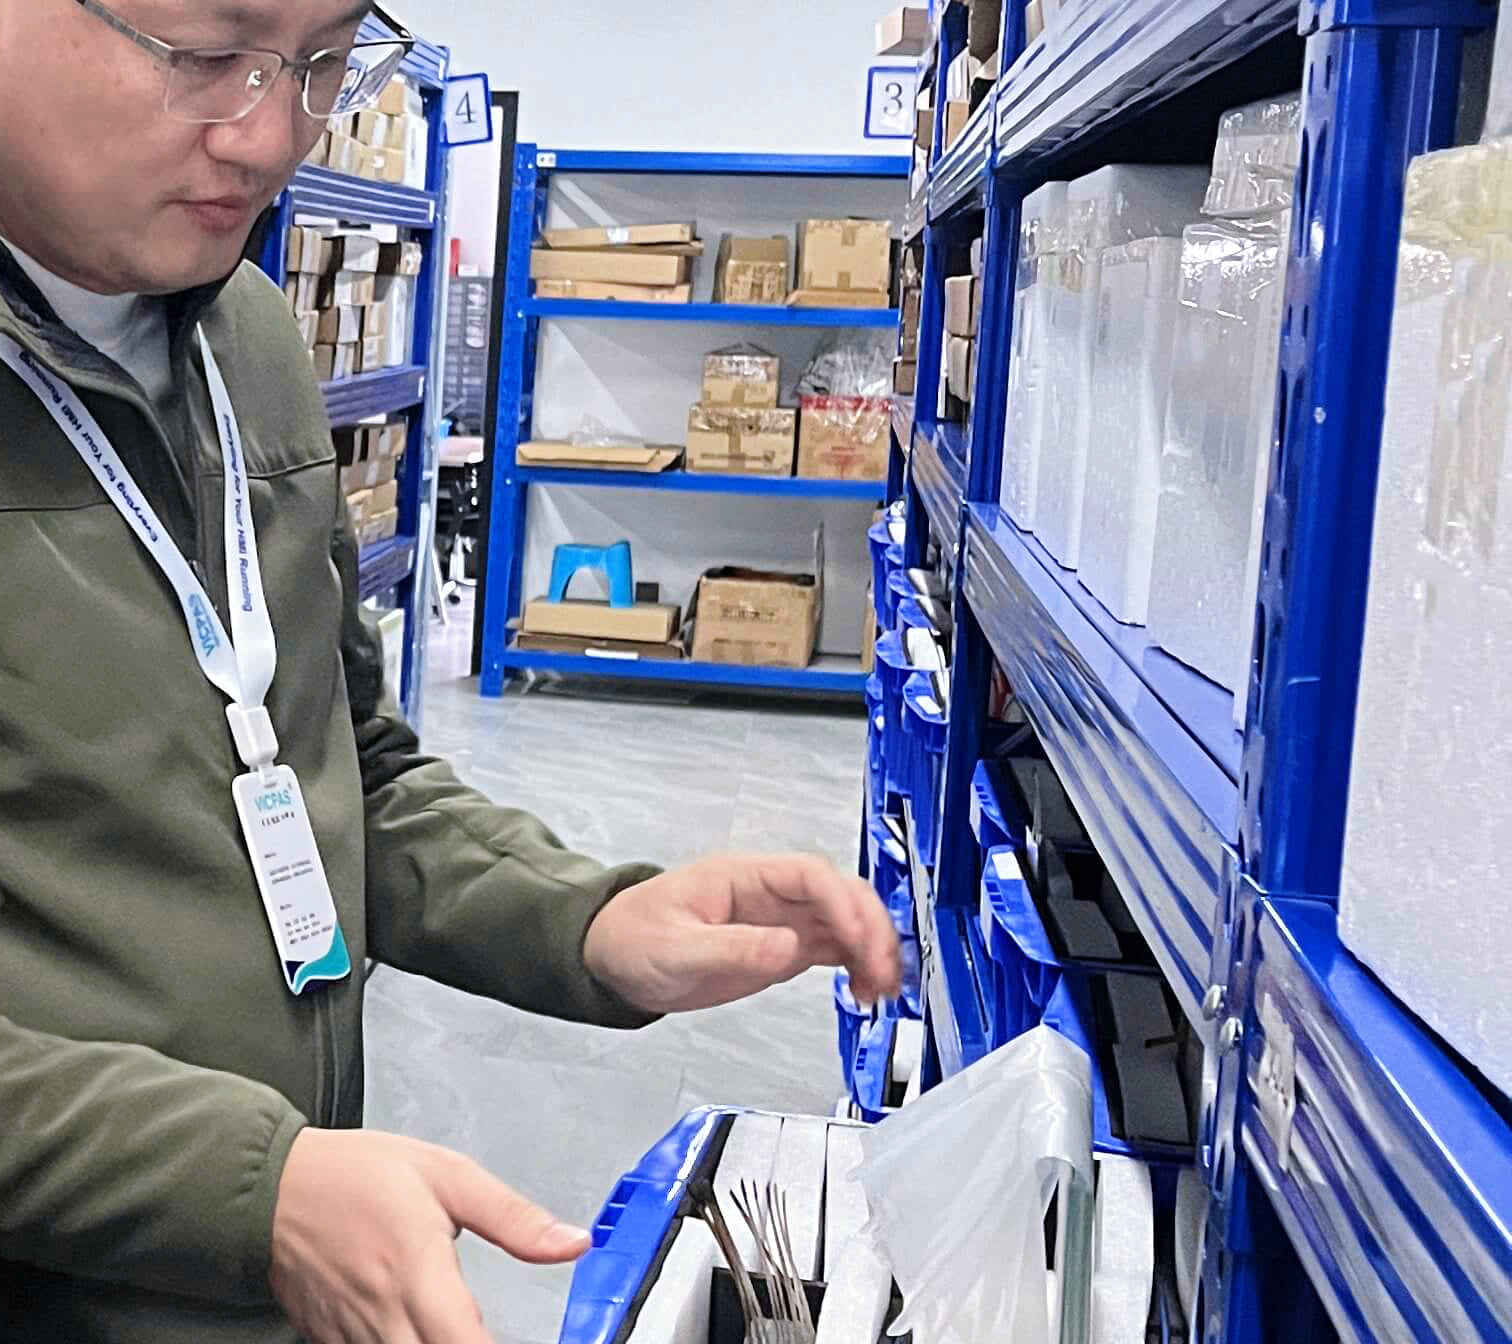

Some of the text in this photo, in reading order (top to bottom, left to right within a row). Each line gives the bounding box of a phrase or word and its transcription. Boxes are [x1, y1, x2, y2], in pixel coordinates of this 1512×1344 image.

[455, 90, 476, 125] 4
[883, 82, 903, 117] 3
[82, 432, 103, 463] Your
[103, 463, 116, 482] for
[240, 557, 253, 612] Running
[254, 789, 292, 813] VICPAS
